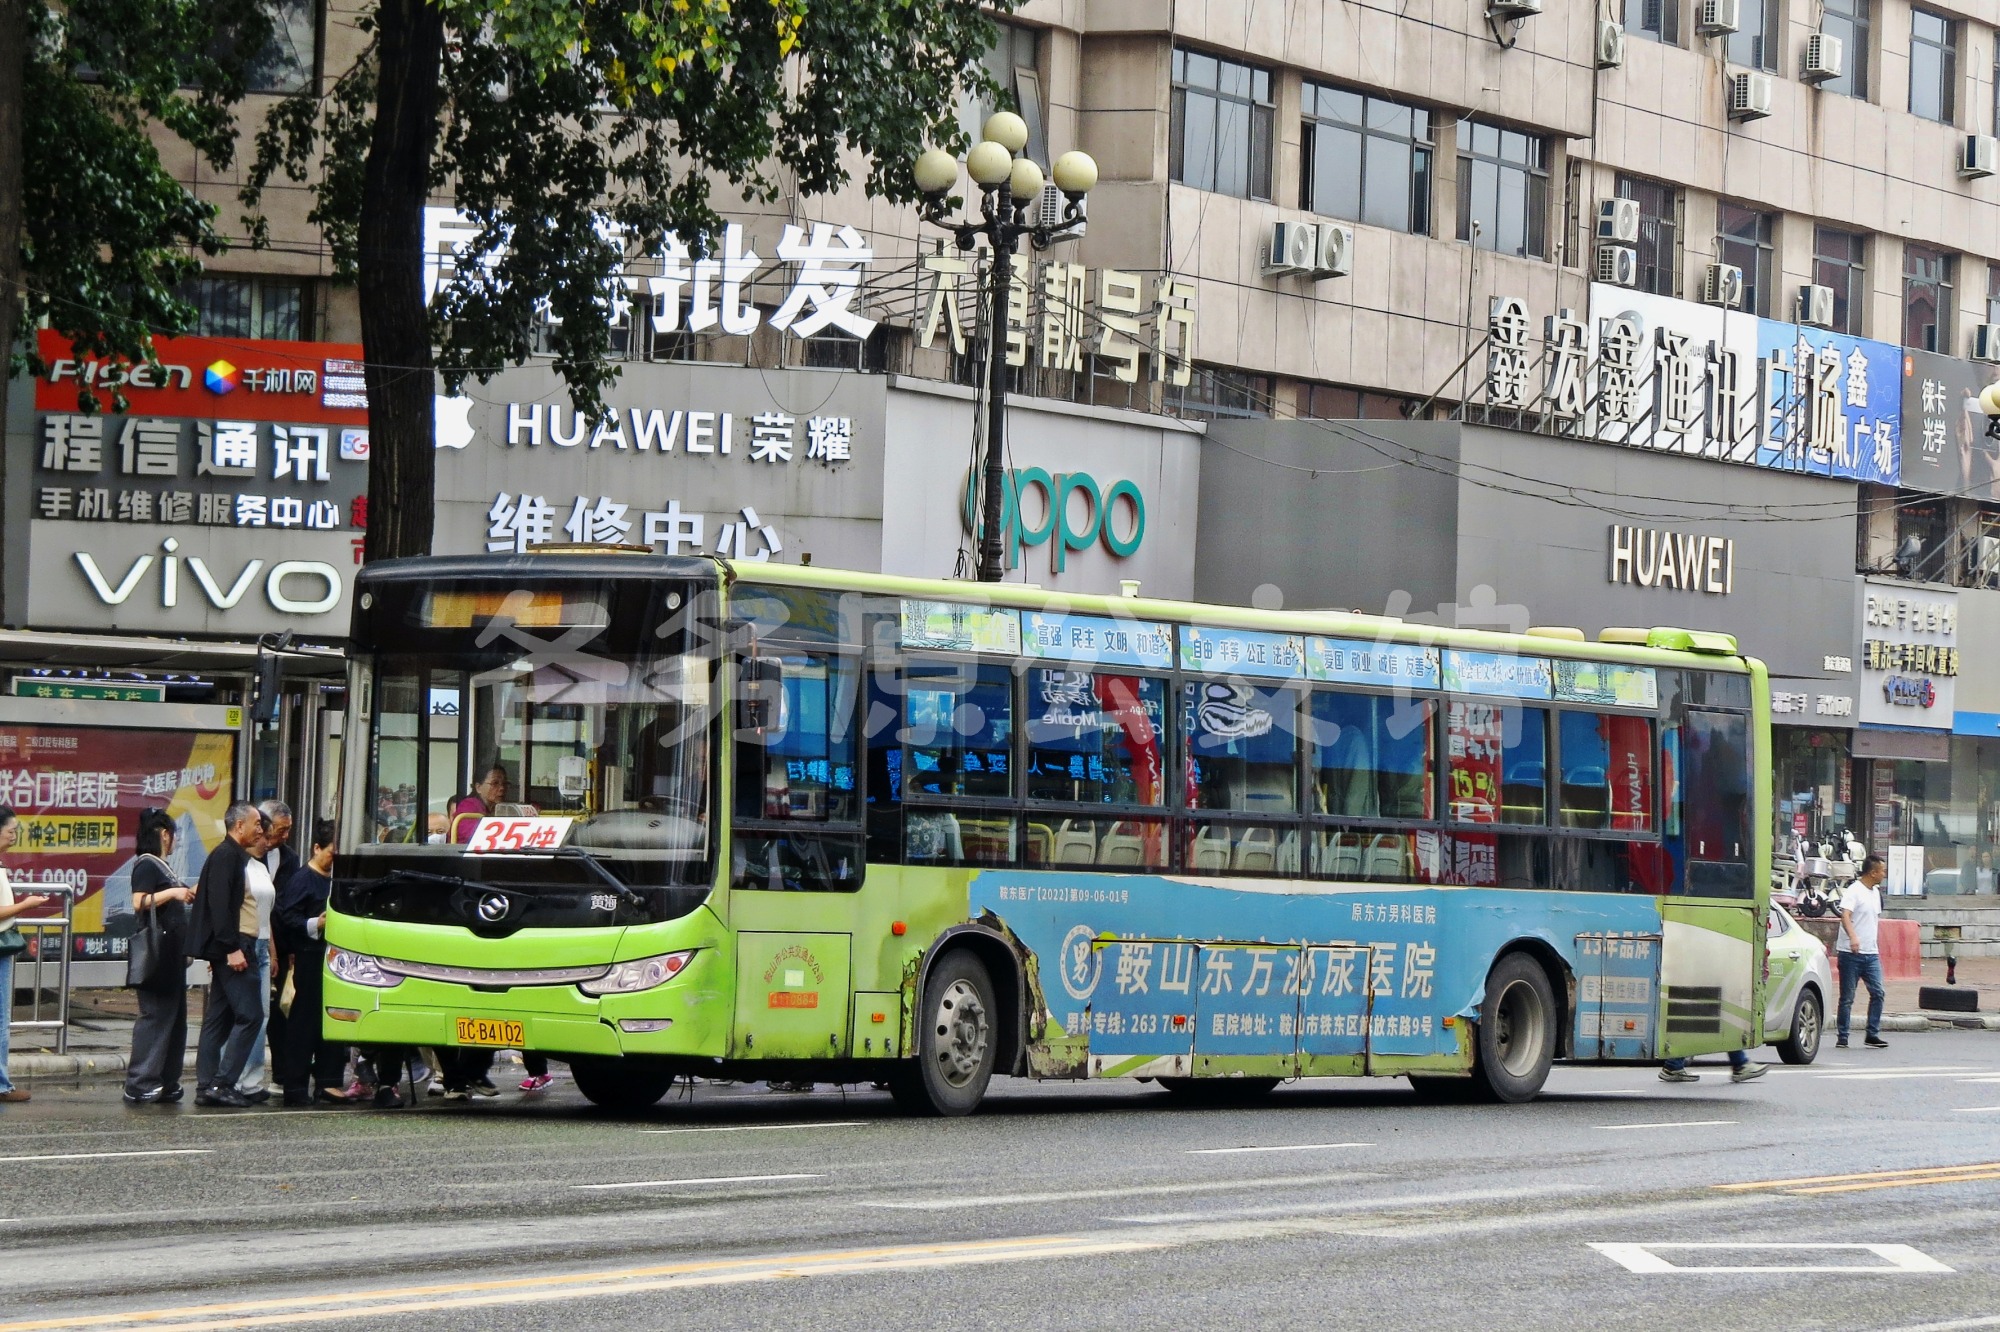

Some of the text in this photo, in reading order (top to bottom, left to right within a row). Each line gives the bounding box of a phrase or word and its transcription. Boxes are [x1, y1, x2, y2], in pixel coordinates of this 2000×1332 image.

[243, 368, 317, 394] 千机网
[42, 414, 332, 481] 程信通讯
[508, 402, 732, 454] HUAWEI
[750, 411, 851, 462] 荣耀
[40, 487, 340, 529] 手机维修服务中心
[486, 491, 782, 563] 维修中心
[73, 536, 342, 614] vivo
[1609, 524, 1733, 594] HUAWEI
[1037, 624, 1062, 648] 富强
[1071, 627, 1095, 650] 民主
[1104, 629, 1127, 653] 文明
[1136, 631, 1160, 655] 和谐
[1193, 638, 1292, 667] 自由 平等 公正 法治
[1324, 649, 1425, 677] 爱国 敬业 诚信 友善
[591, 894, 617, 911] 黄海
[1352, 903, 1437, 924] 原东方男科医院
[1115, 933, 1437, 998] 鞍山东方泌尿医院
[1131, 1014, 1157, 1034] 263
